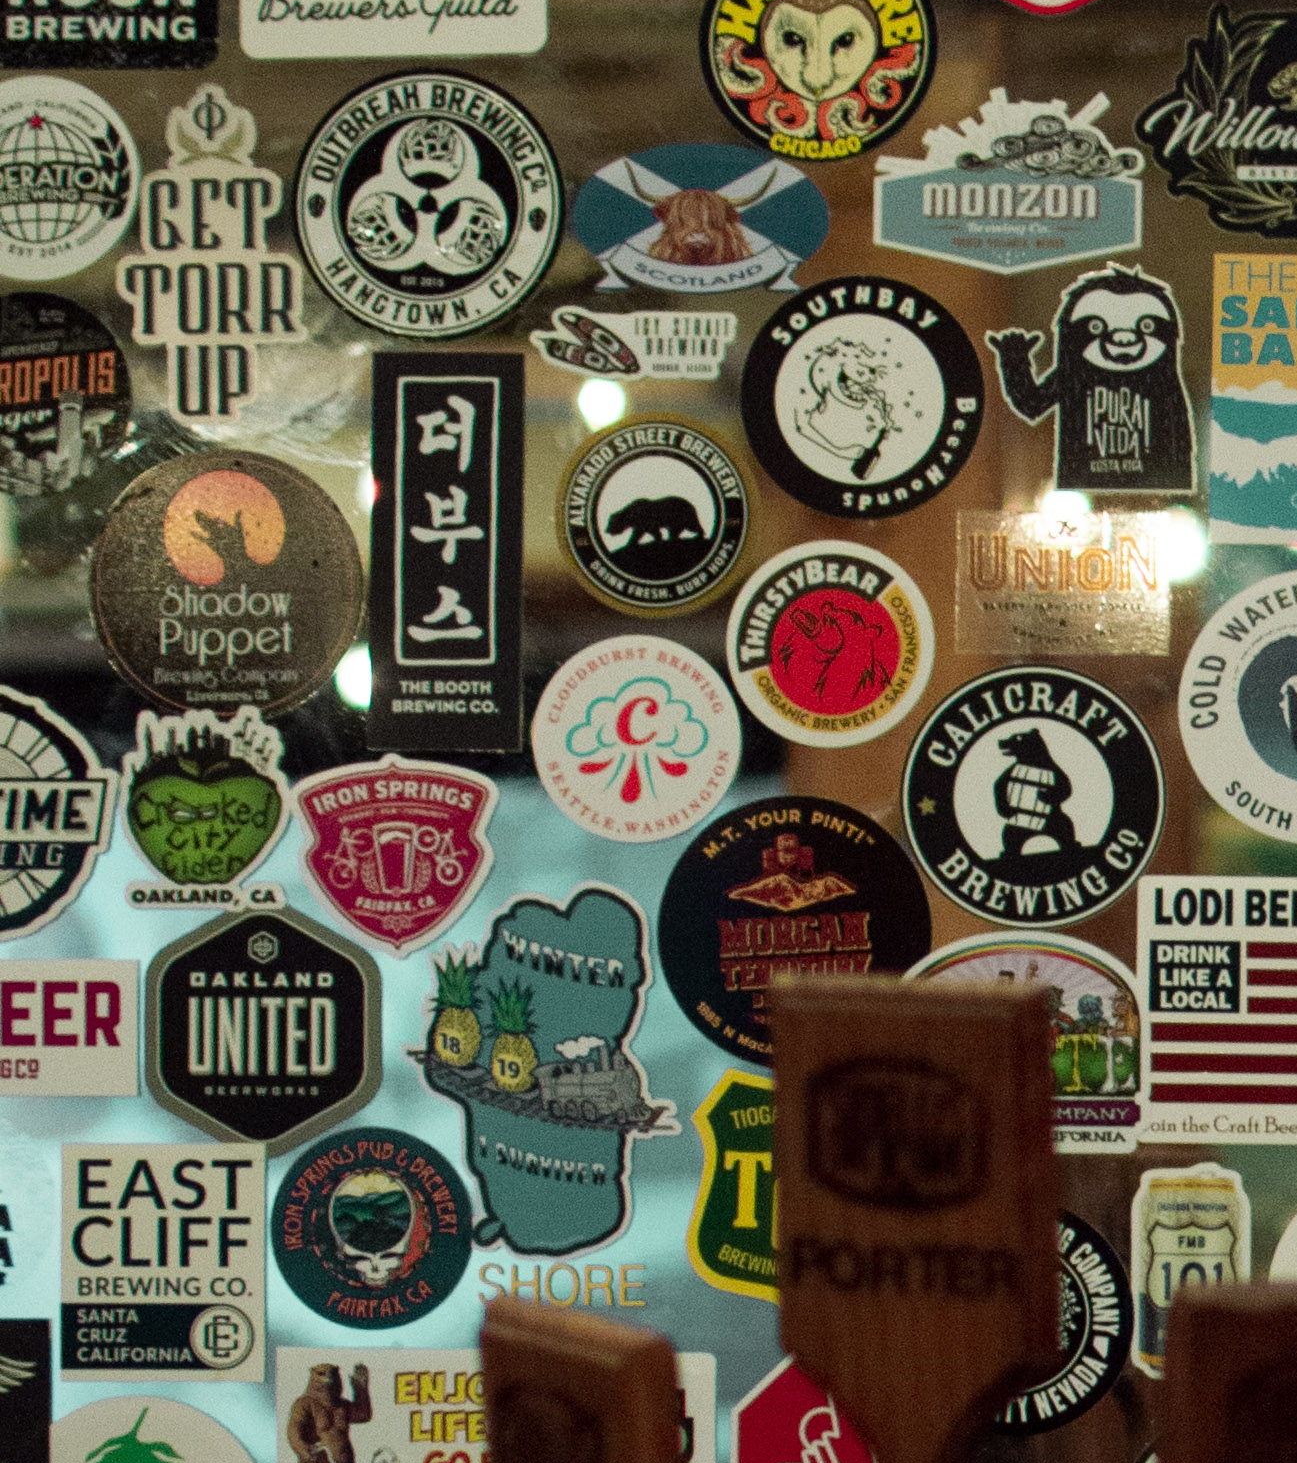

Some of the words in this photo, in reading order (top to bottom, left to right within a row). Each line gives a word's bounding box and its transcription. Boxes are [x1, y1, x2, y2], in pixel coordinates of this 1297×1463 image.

[5, 16, 198, 41] BREWING
[770, 135, 861, 160] CHICAGO
[147, 178, 280, 251] GET
[1221, 261, 1295, 293] THE
[125, 261, 295, 336] TORR
[176, 345, 254, 417] UP
[410, 395, 483, 642] 더부스
[159, 585, 290, 618] Shadow
[159, 620, 293, 664] Puppet
[400, 681, 429, 695] THE
[433, 680, 491, 695] BOOTH
[392, 700, 465, 714] BREWING
[470, 700, 499, 714] CO.
[1154, 888, 1235, 926] LODI
[1157, 944, 1231, 965] DRINK
[189, 972, 334, 988] OAKLAND
[1158, 968, 1207, 987] LIKE
[1213, 969, 1232, 987] A
[1159, 991, 1232, 1011] LOCAL
[187, 996, 336, 1076] UNITED
[78, 1159, 253, 1210] EAST
[72, 1216, 253, 1267] CLIFF
[78, 1277, 202, 1298] BREWING
[209, 1277, 254, 1298] CO.
